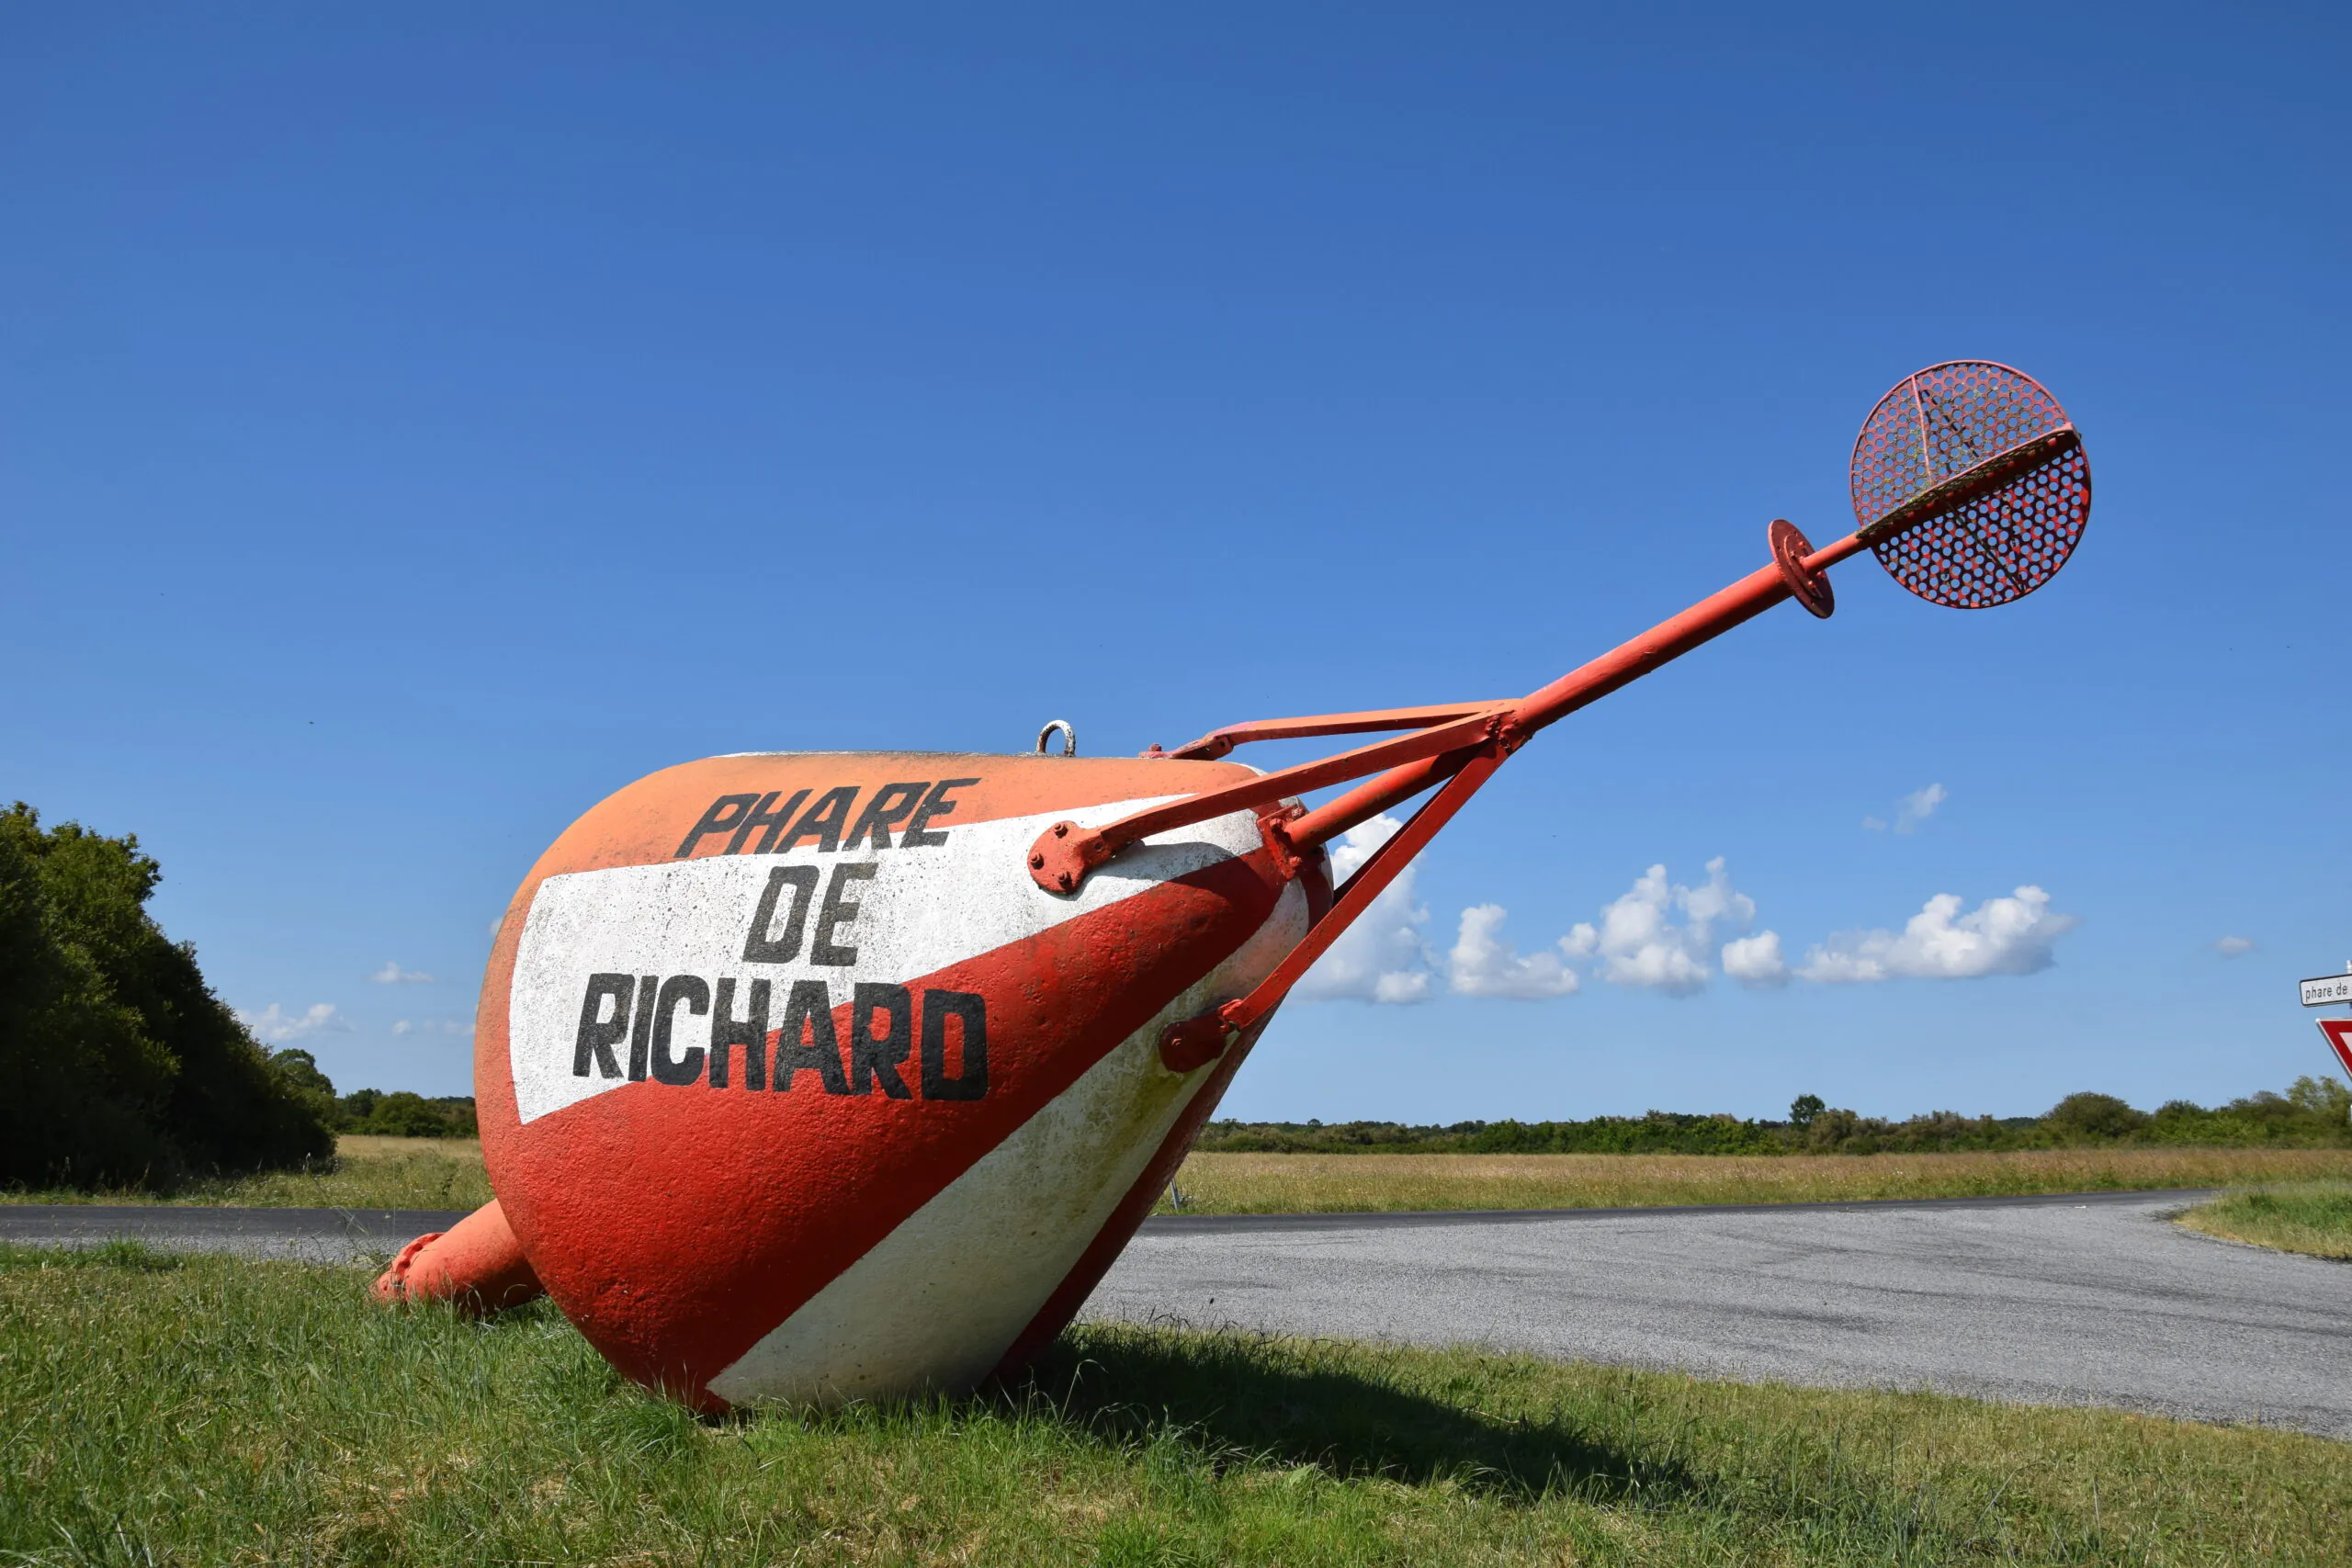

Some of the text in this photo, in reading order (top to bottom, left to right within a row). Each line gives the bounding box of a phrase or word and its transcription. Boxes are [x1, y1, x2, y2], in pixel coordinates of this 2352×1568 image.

[673, 777, 982, 859] PHARE
[741, 862, 879, 967] DE
[571, 972, 989, 1102] RICHARD
[2305, 982, 2347, 1002] phare de
